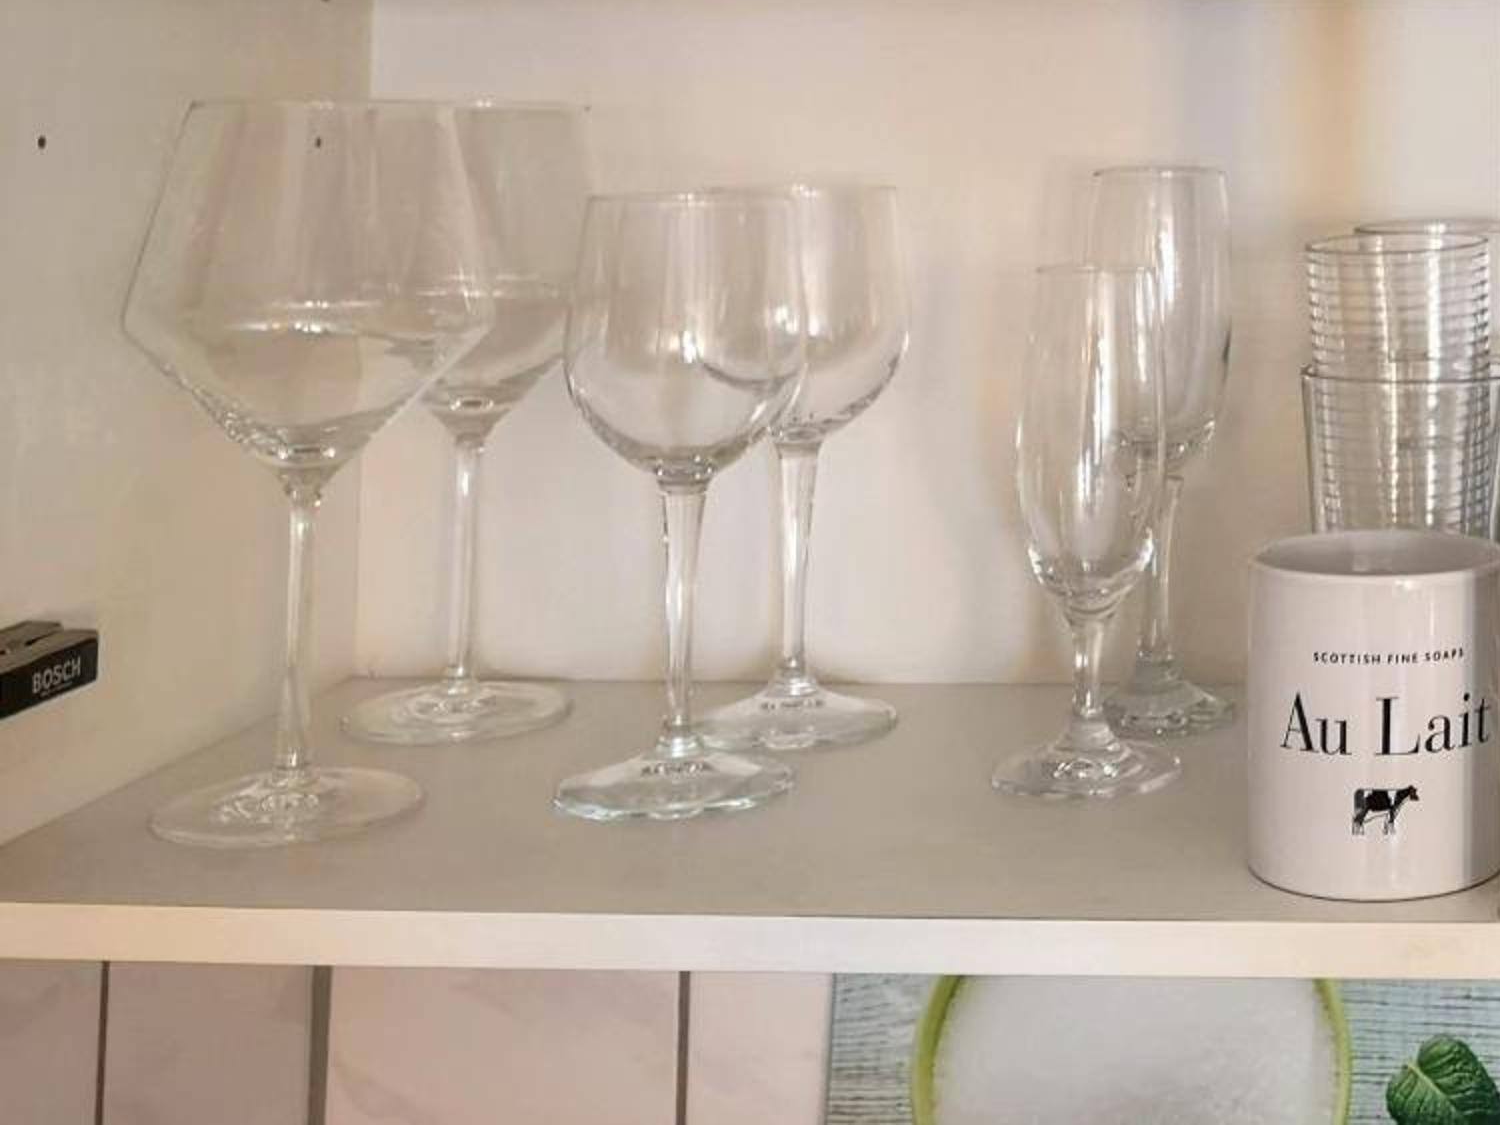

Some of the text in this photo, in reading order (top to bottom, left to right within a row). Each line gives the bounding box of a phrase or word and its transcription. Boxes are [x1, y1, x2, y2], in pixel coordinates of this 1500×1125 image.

[31, 655, 82, 694] BOSCH
[1313, 651, 1382, 665] SCOTTISH
[1387, 652, 1419, 665] FINE
[1279, 691, 1492, 756] Au Lait
